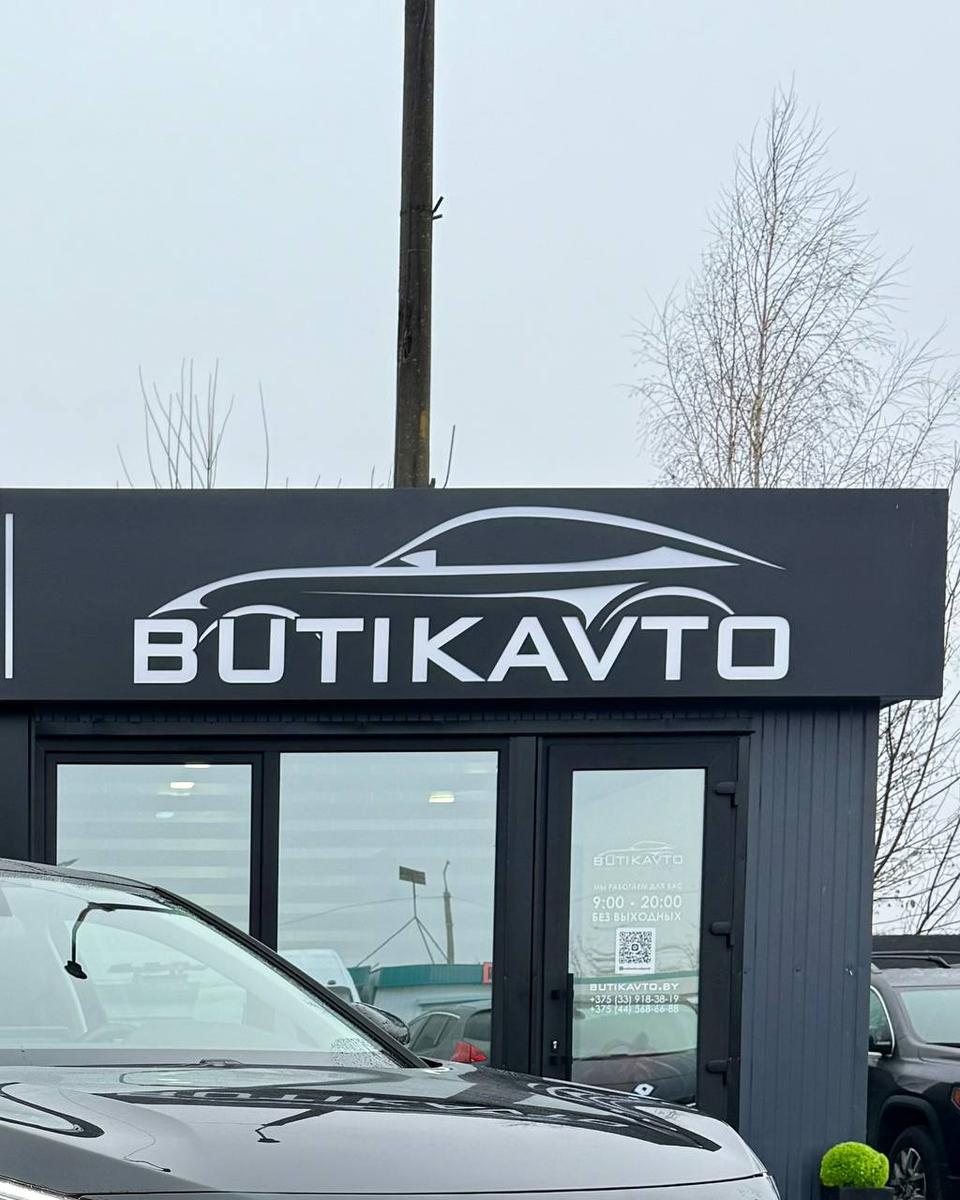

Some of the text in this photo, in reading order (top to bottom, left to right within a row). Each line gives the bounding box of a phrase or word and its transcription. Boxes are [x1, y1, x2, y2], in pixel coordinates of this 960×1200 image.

[133, 615, 791, 684] BUTIKAVTO
[593, 854, 683, 866] BUTIKAVTO
[592, 896, 625, 909] 9:00
[640, 895, 682, 909] 20:00
[592, 912, 681, 922] БЕЗ ВЫХОДНЫХ
[589, 983, 680, 991] BUTIKAVTO.BY
[590, 994, 679, 1006] +375 (33) 918-38-19
[590, 1004, 612, 1014] +375
[614, 1004, 632, 1016] (44)
